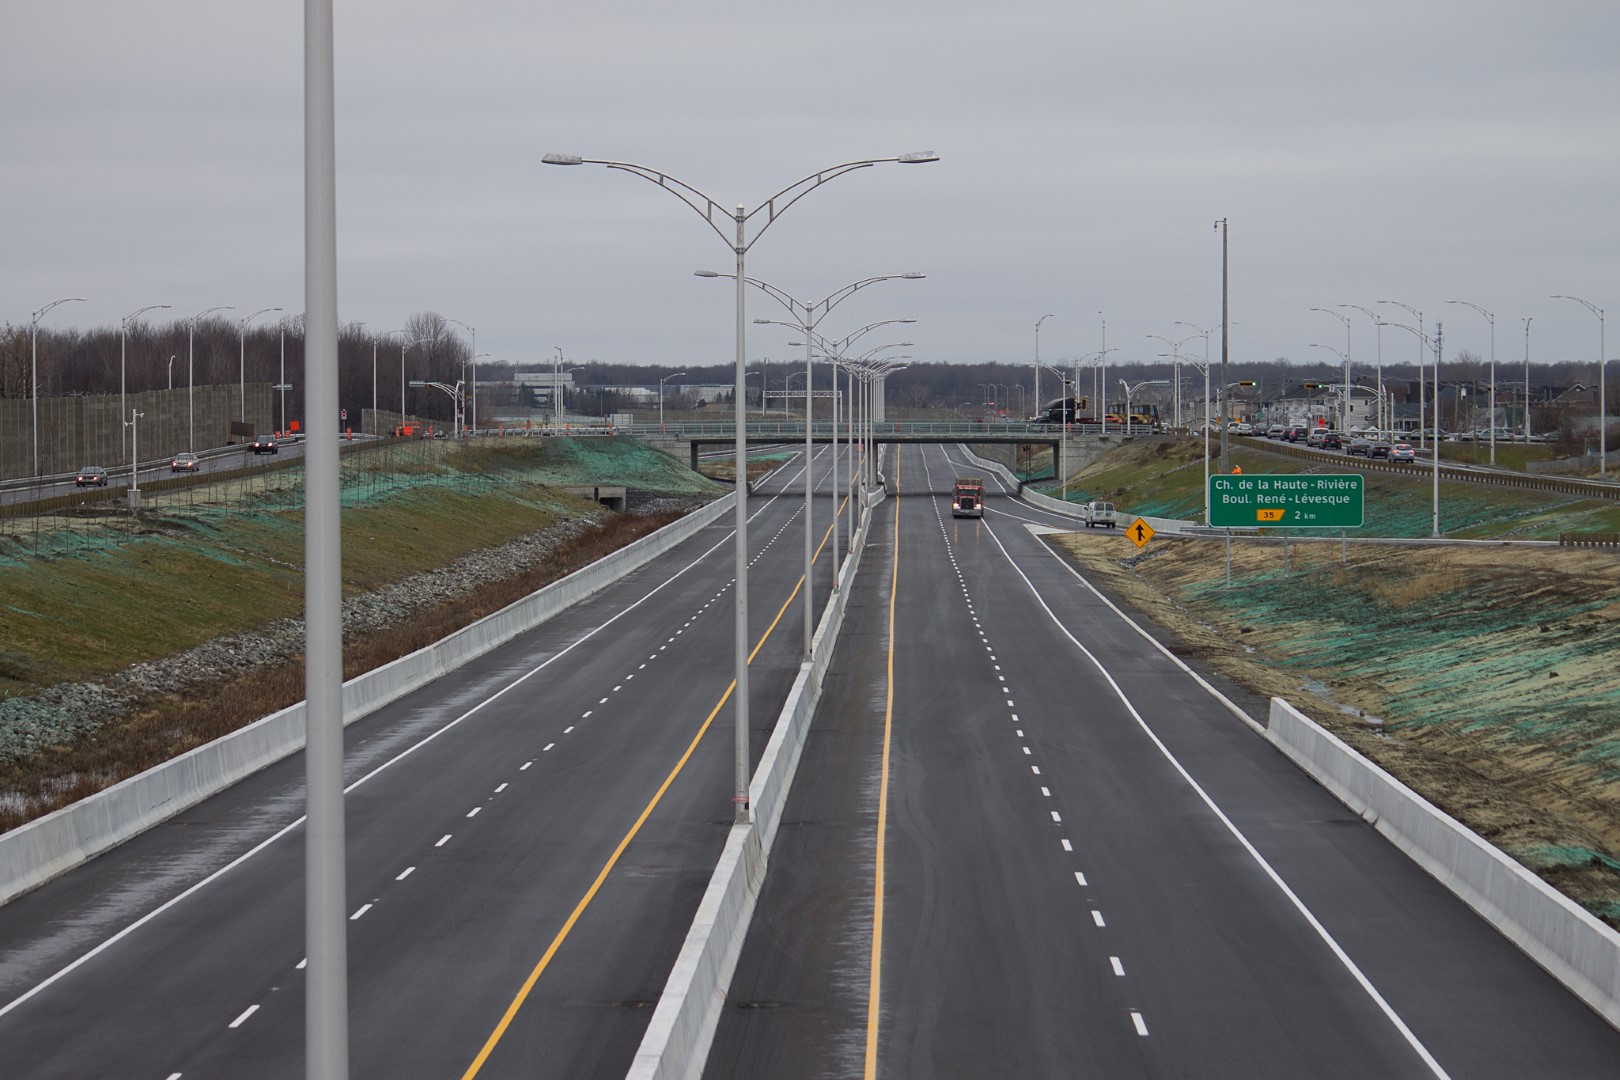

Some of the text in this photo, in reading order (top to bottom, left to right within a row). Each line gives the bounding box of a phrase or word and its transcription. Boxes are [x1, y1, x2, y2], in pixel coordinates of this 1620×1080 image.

[1215, 480, 1234, 490] Ch.
[1238, 480, 1253, 490] de
[1258, 480, 1269, 490] la
[1222, 494, 1252, 504] Boul.
[1263, 511, 1275, 519] 35
[1294, 511, 1301, 520] 2
